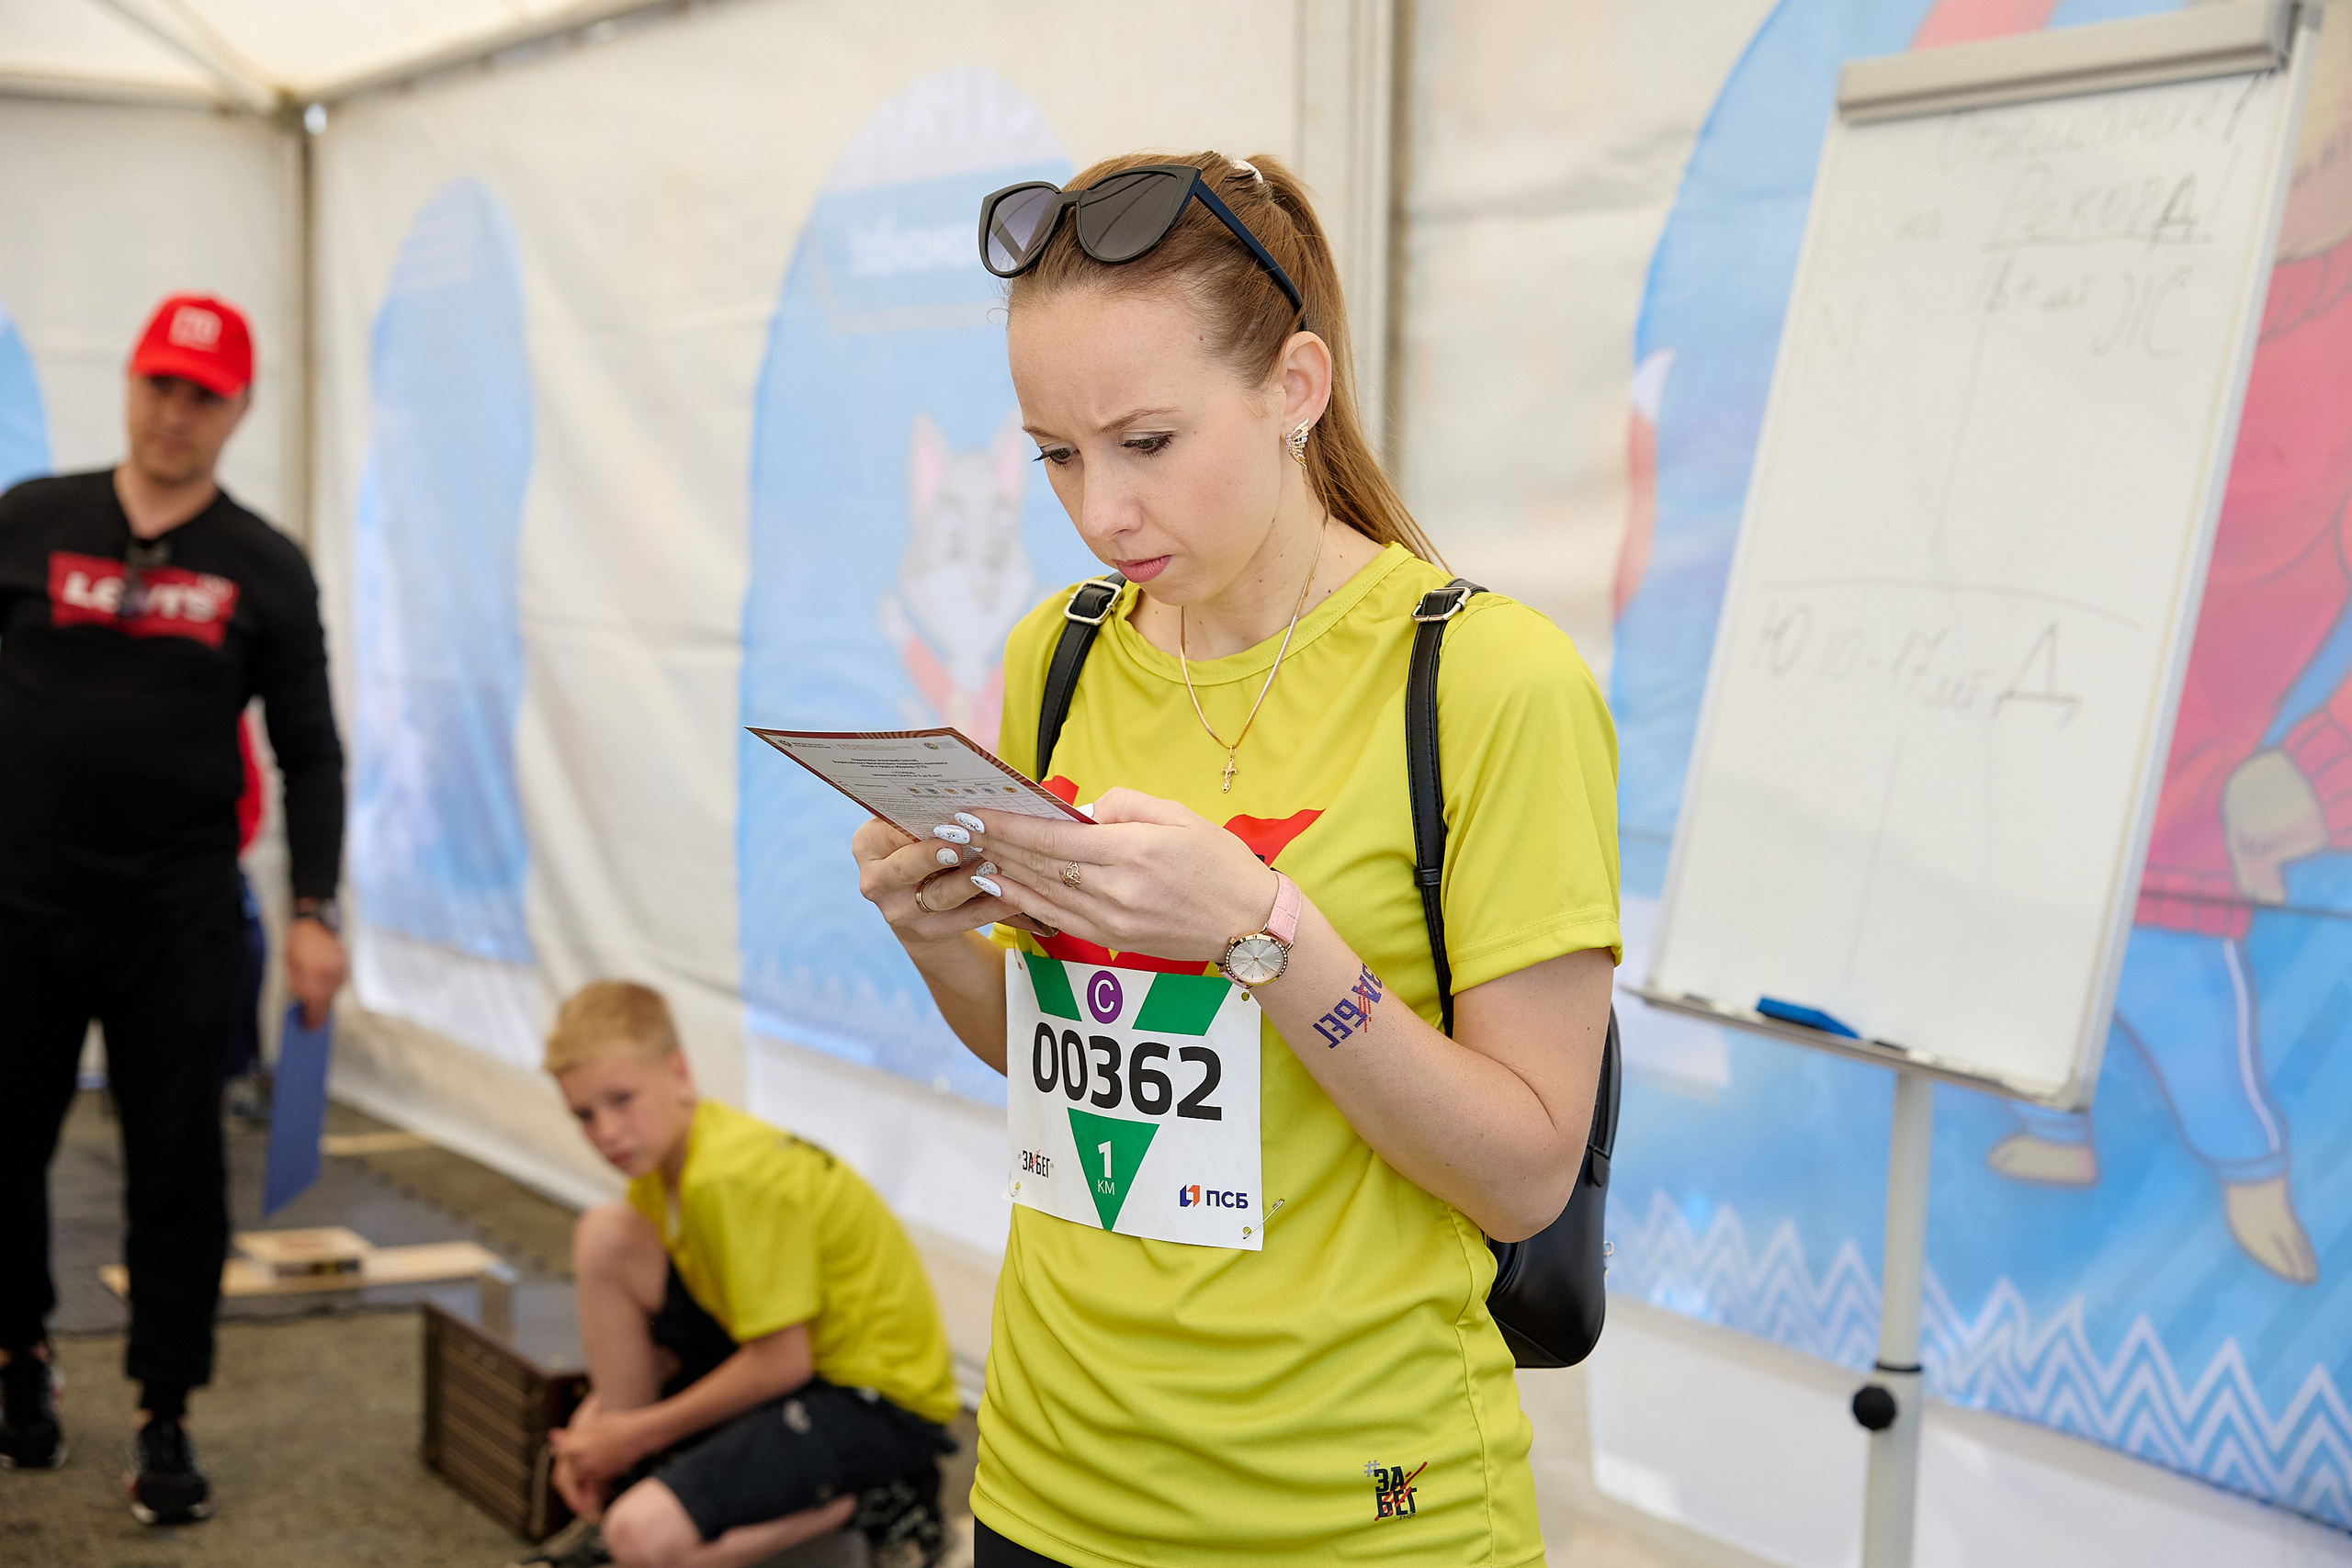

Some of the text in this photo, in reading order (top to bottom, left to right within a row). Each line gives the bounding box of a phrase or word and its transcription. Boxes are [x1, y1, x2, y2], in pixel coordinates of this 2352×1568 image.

[1986, 615, 2085, 733] Д
[1033, 1021, 1223, 1122] 00362
[1097, 1140, 1113, 1179] 1
[1097, 1179, 1115, 1196] КМ
[1205, 1190, 1249, 1209] ПСБ
